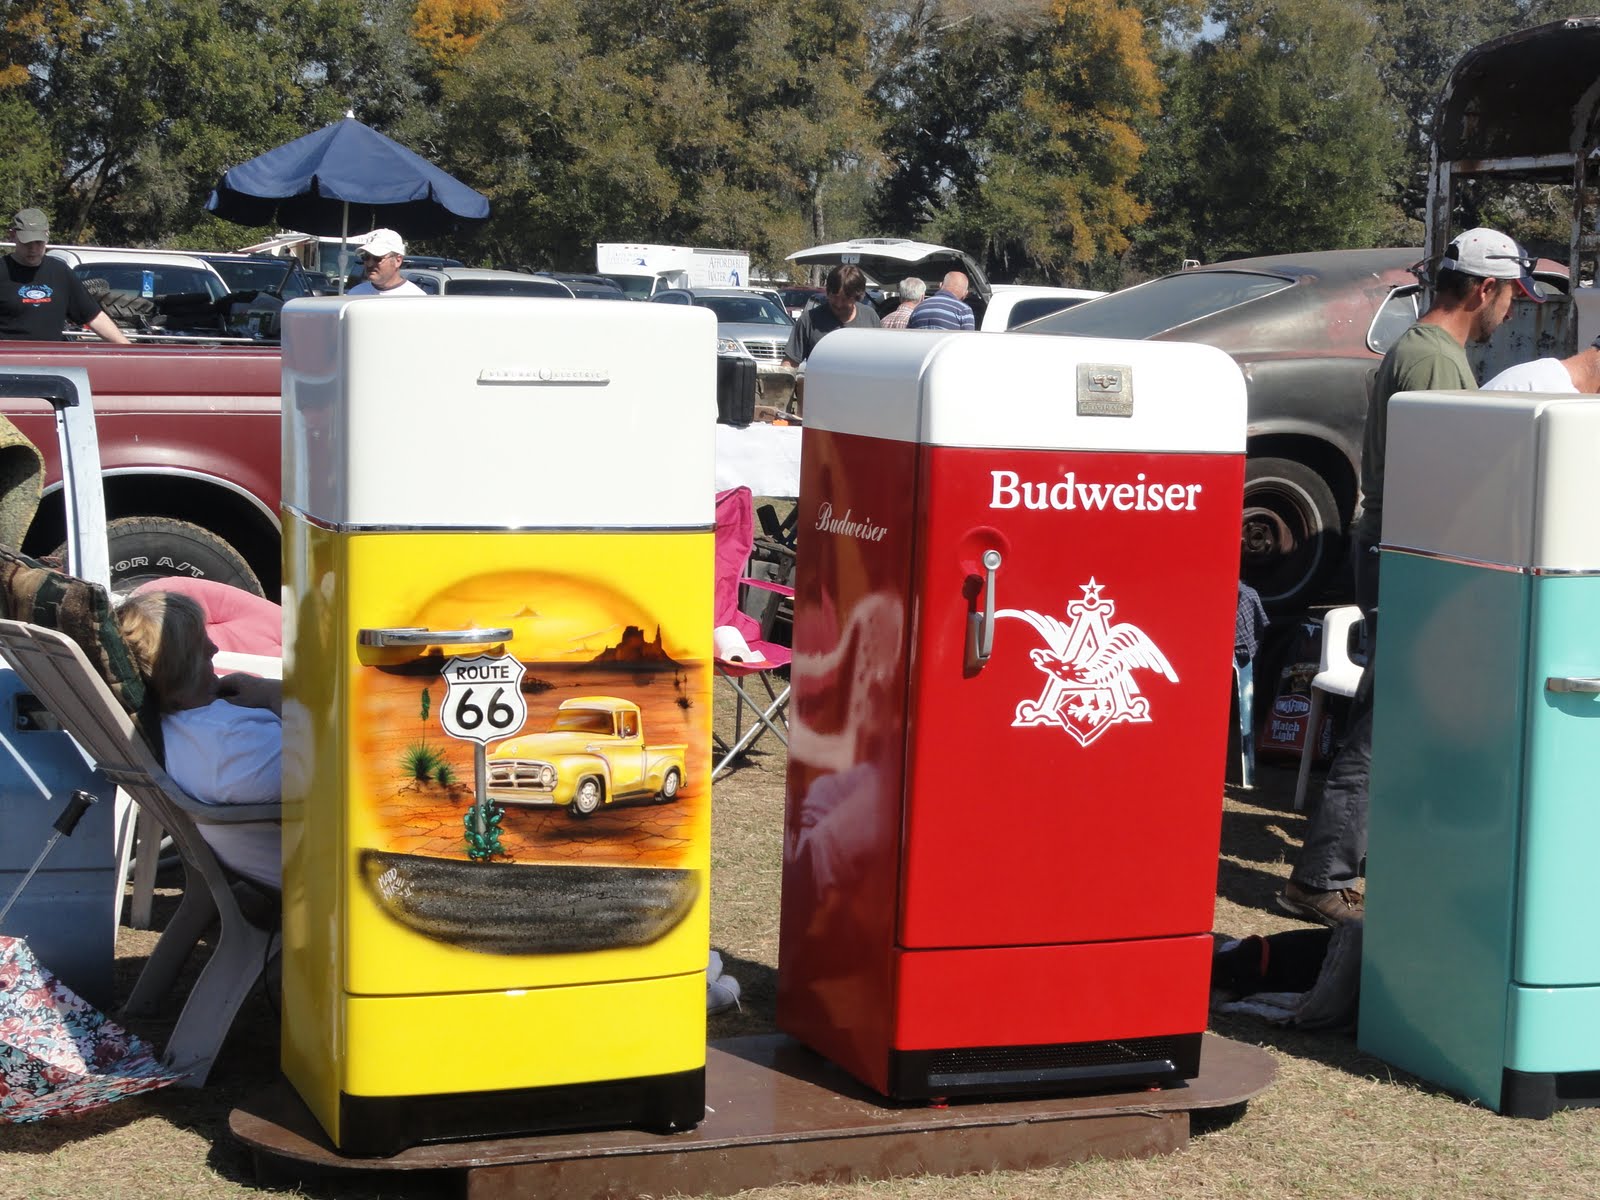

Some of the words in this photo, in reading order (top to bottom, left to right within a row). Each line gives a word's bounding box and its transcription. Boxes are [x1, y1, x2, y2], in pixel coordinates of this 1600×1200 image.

[708, 257, 745, 269] AFFORDABLE
[708, 270, 727, 282] WATER
[989, 470, 1202, 511] Budweiser
[815, 501, 888, 543] Budweiser
[156, 556, 205, 578] A/T
[456, 665, 510, 680] ROUTE
[455, 687, 515, 730] 66
[1275, 699, 1309, 713] KINGSFORD
[1271, 720, 1300, 732] Match
[1271, 729, 1297, 742] Light
